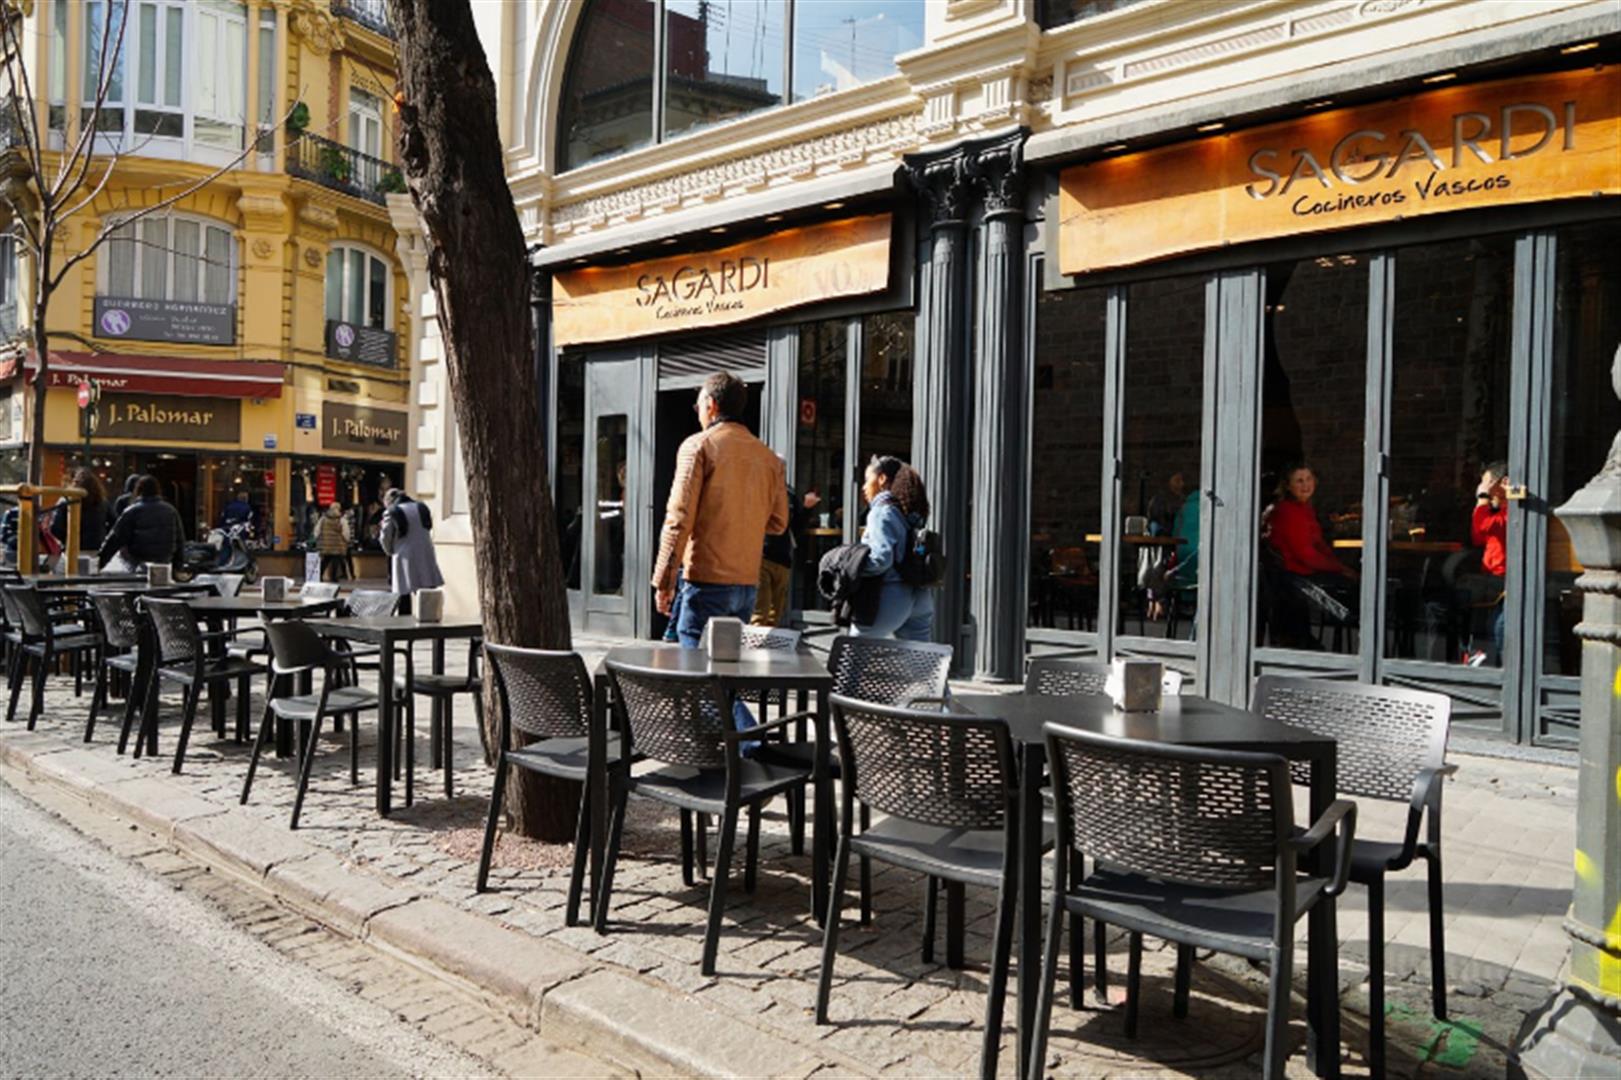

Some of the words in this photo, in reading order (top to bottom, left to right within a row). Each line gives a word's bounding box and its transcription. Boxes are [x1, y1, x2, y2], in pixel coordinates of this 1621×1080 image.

[1244, 101, 1576, 201] SAGARDI
[1292, 188, 1406, 217] Cocineros
[1415, 171, 1511, 201] Vascos
[636, 257, 769, 306] SAGARDI
[67, 373, 129, 388] Palmar
[109, 403, 123, 425] J.
[127, 403, 213, 426] Palomar
[332, 418, 342, 437] J.
[344, 419, 401, 441] Palomar
